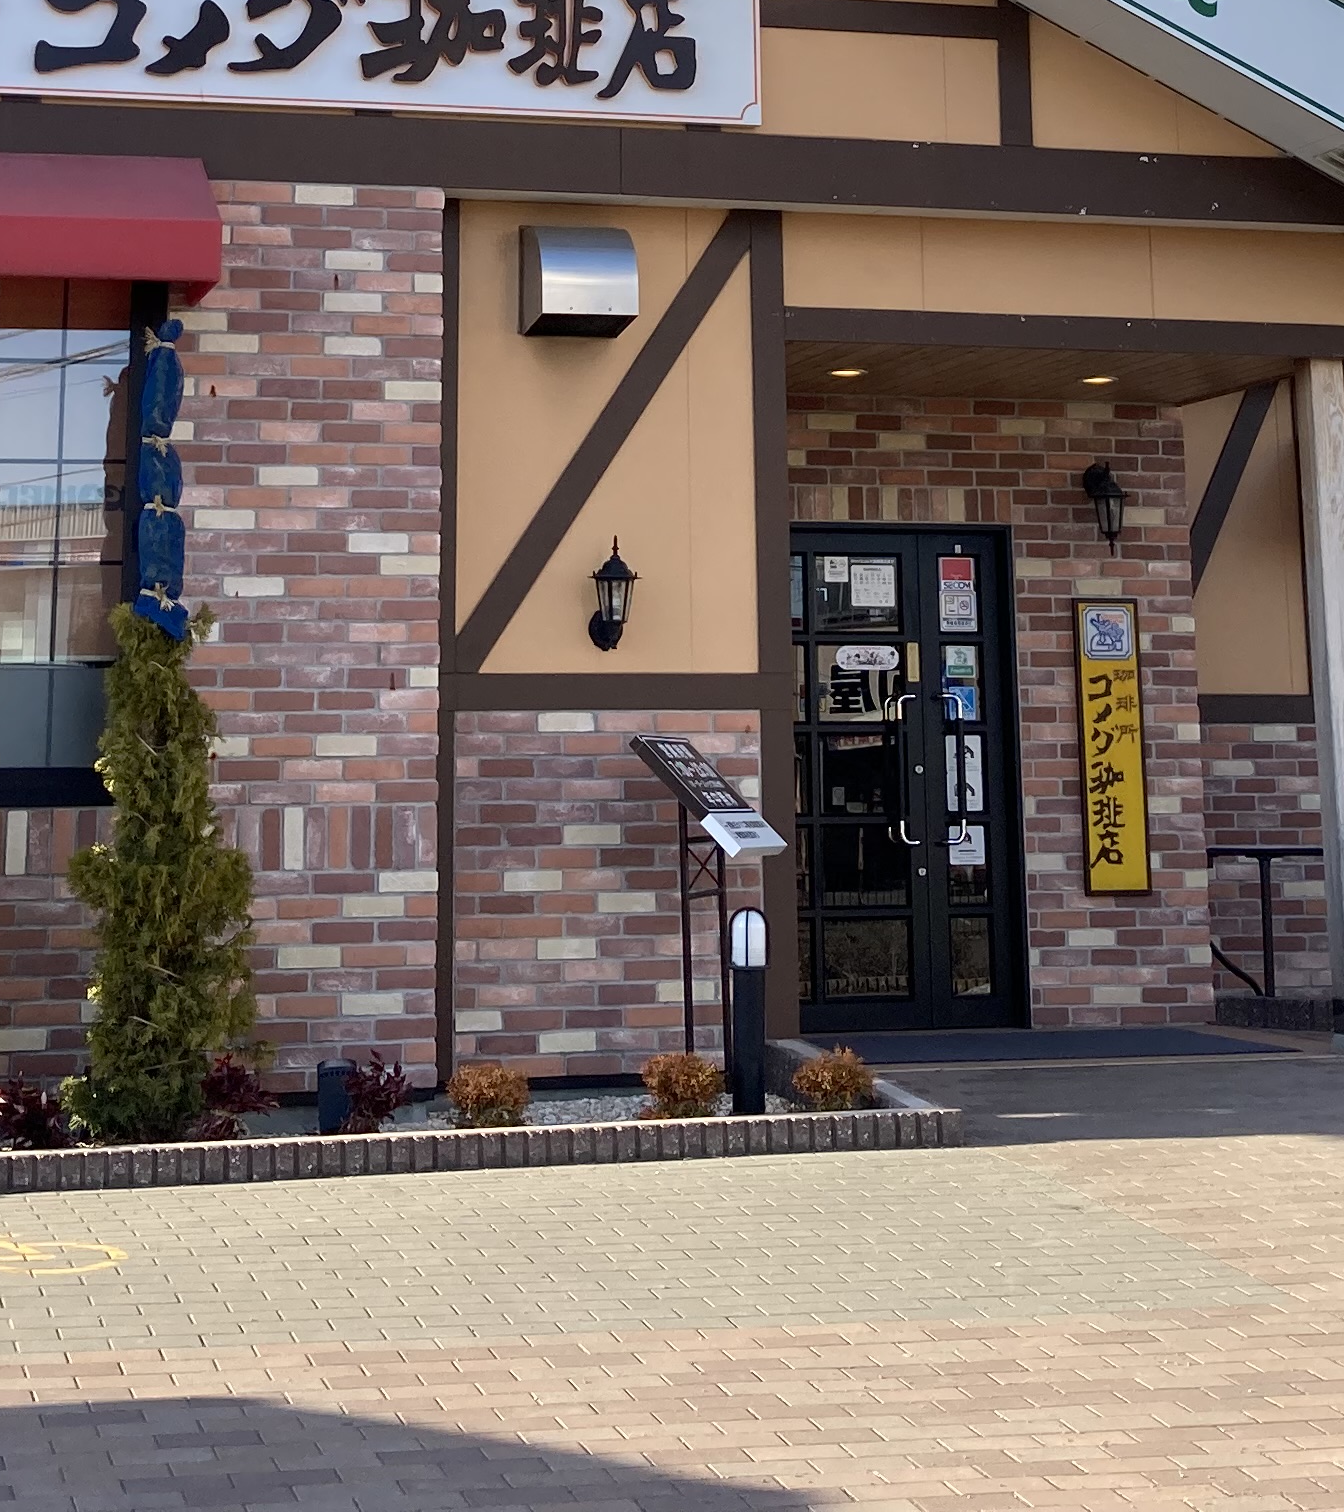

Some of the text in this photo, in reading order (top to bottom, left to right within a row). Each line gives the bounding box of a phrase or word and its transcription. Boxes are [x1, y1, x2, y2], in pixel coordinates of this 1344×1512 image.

[943, 581, 971, 590] SECOM
[1113, 669, 1139, 744] 珈琲所
[1088, 673, 1126, 869] コメダ珈琲店
